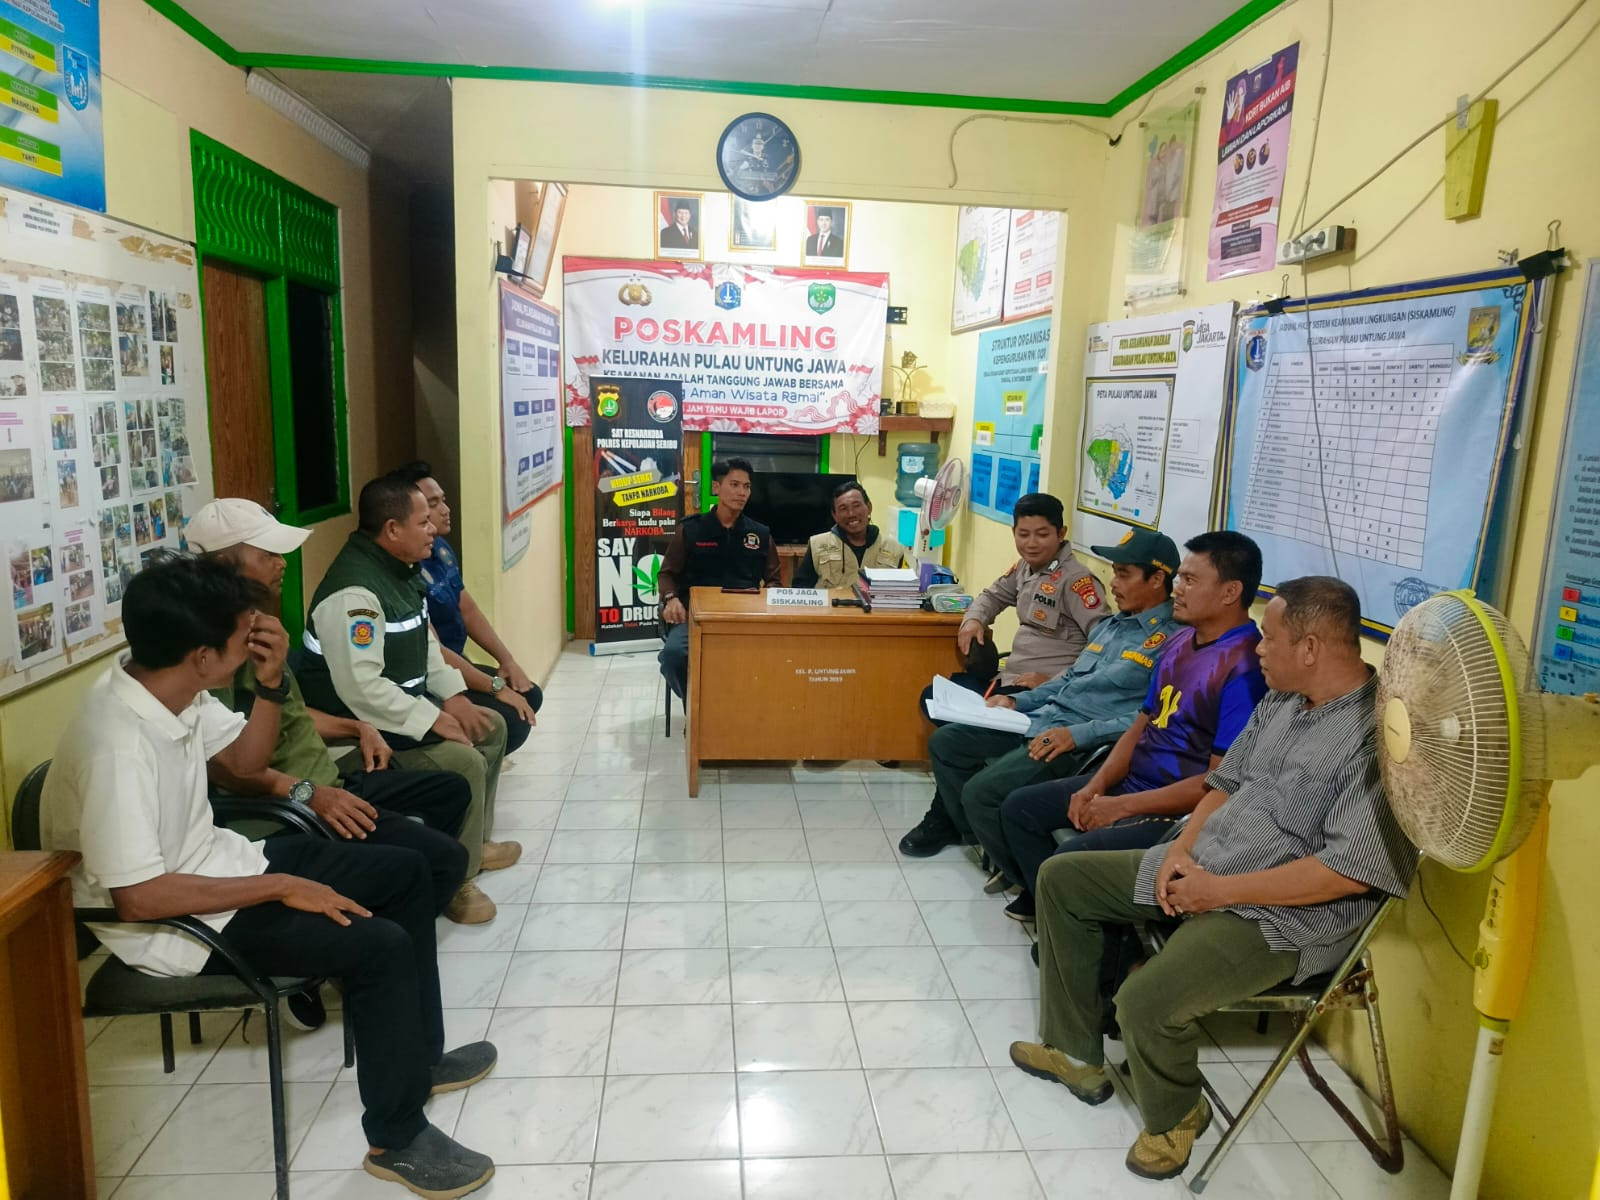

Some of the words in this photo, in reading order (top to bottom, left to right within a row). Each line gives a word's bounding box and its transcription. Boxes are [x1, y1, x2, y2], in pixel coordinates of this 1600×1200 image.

[1259, 87, 1280, 112] BUKAN
[1312, 319, 1330, 329] SISTEM
[1331, 316, 1364, 327] KEAMANAN
[1364, 311, 1407, 325] LINGKUNGAN
[1407, 305, 1456, 323] (SISKAMLING)
[614, 316, 836, 350] POSKAMLING
[1340, 334, 1359, 344] PULAU
[1359, 331, 1386, 343] UNTUNG
[1387, 330, 1406, 340] JAWA
[602, 349, 690, 368] KELURAHAN
[694, 353, 741, 371] PULAU
[745, 355, 804, 373] UNTUNG
[807, 358, 847, 374] JAWA
[706, 374, 760, 387] TANGGUNG
[763, 377, 797, 388] JAWAB
[799, 378, 844, 389] BERSAMA
[690, 387, 726, 399] Aman
[731, 388, 778, 401] Wisata
[1108, 389, 1122, 399] PULAU
[687, 404, 704, 414] JAM
[706, 404, 727, 415] TAMU
[729, 405, 755, 416] WAJIB
[756, 407, 785, 417] LAPOR
[641, 485, 669, 499] NARKOBA
[629, 508, 651, 518] Siapa
[638, 518, 657, 526] kudu
[597, 537, 637, 557] SAY
[598, 553, 665, 607] NO
[771, 598, 824, 606] SISKAMLING
[1033, 593, 1056, 608] POLRI
[599, 607, 619, 624] TO
